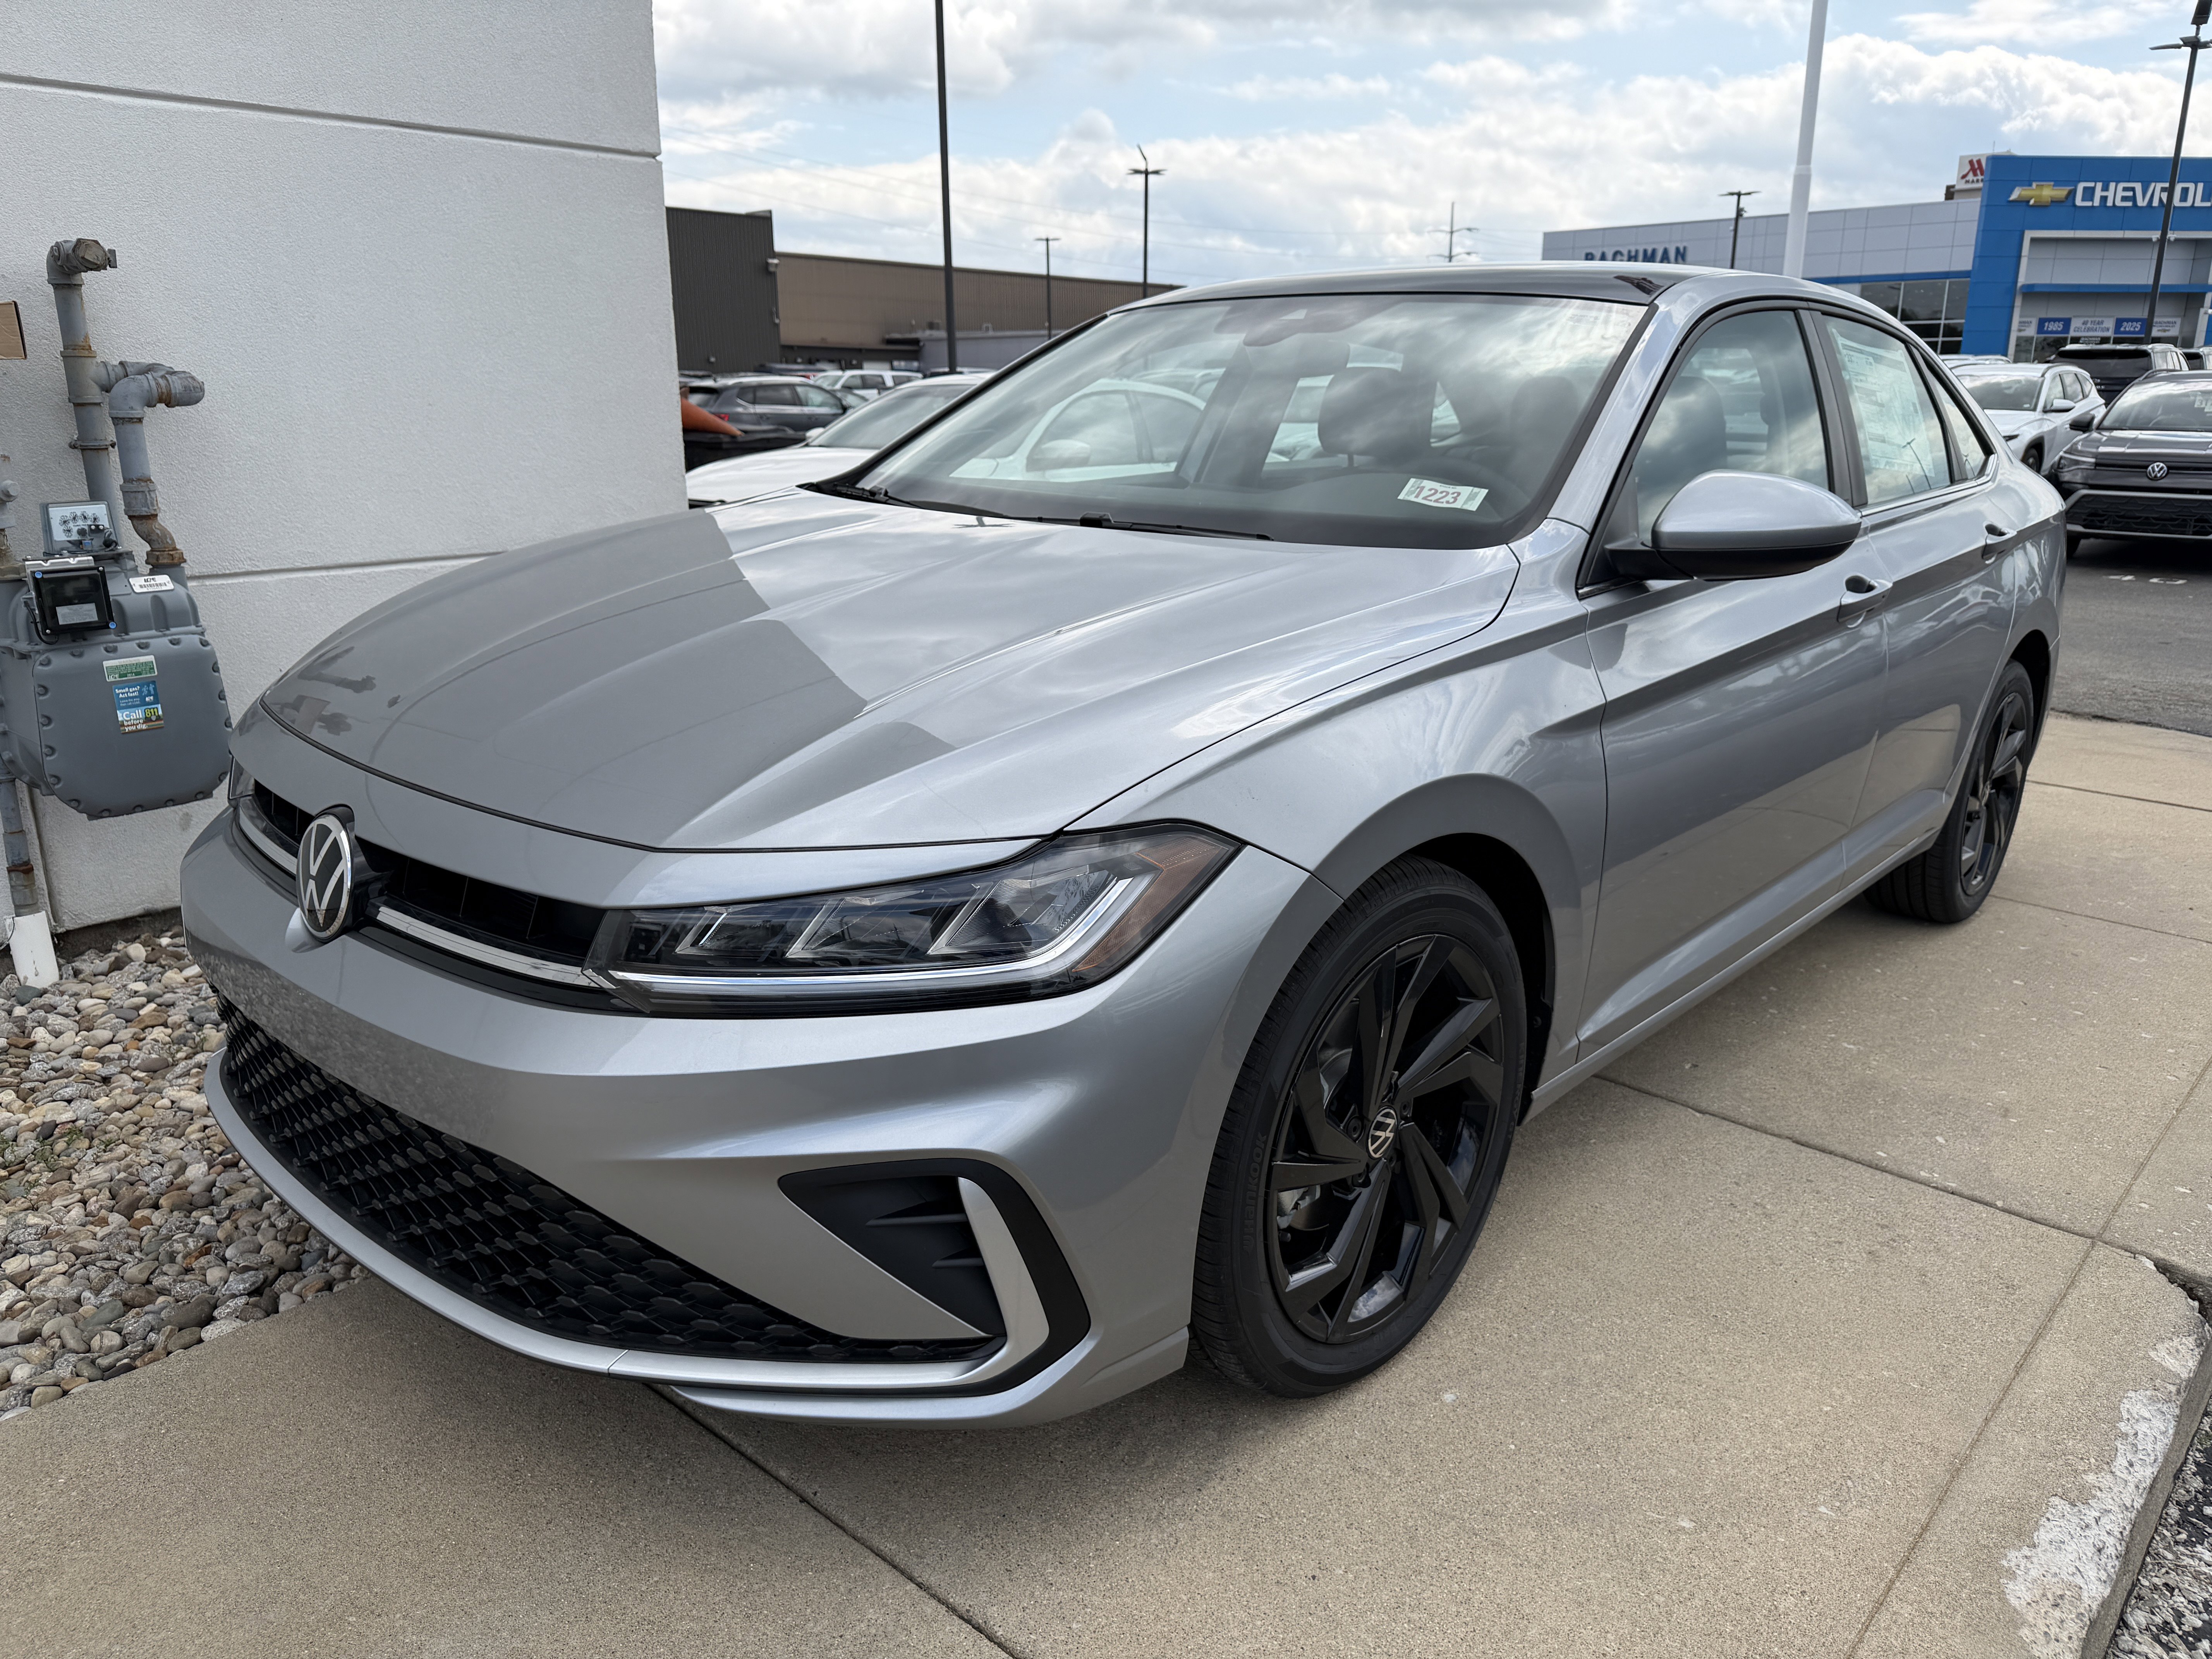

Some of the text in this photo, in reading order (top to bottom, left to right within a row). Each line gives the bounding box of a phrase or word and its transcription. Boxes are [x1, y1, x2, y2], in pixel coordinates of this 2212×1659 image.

[2075, 182, 2212, 207] CHEVROL
[2044, 321, 2064, 331] 1985
[2120, 321, 2142, 331] 2025
[1414, 486, 1461, 505] 1223
[123, 709, 142, 720] Call
[145, 708, 158, 718] 811
